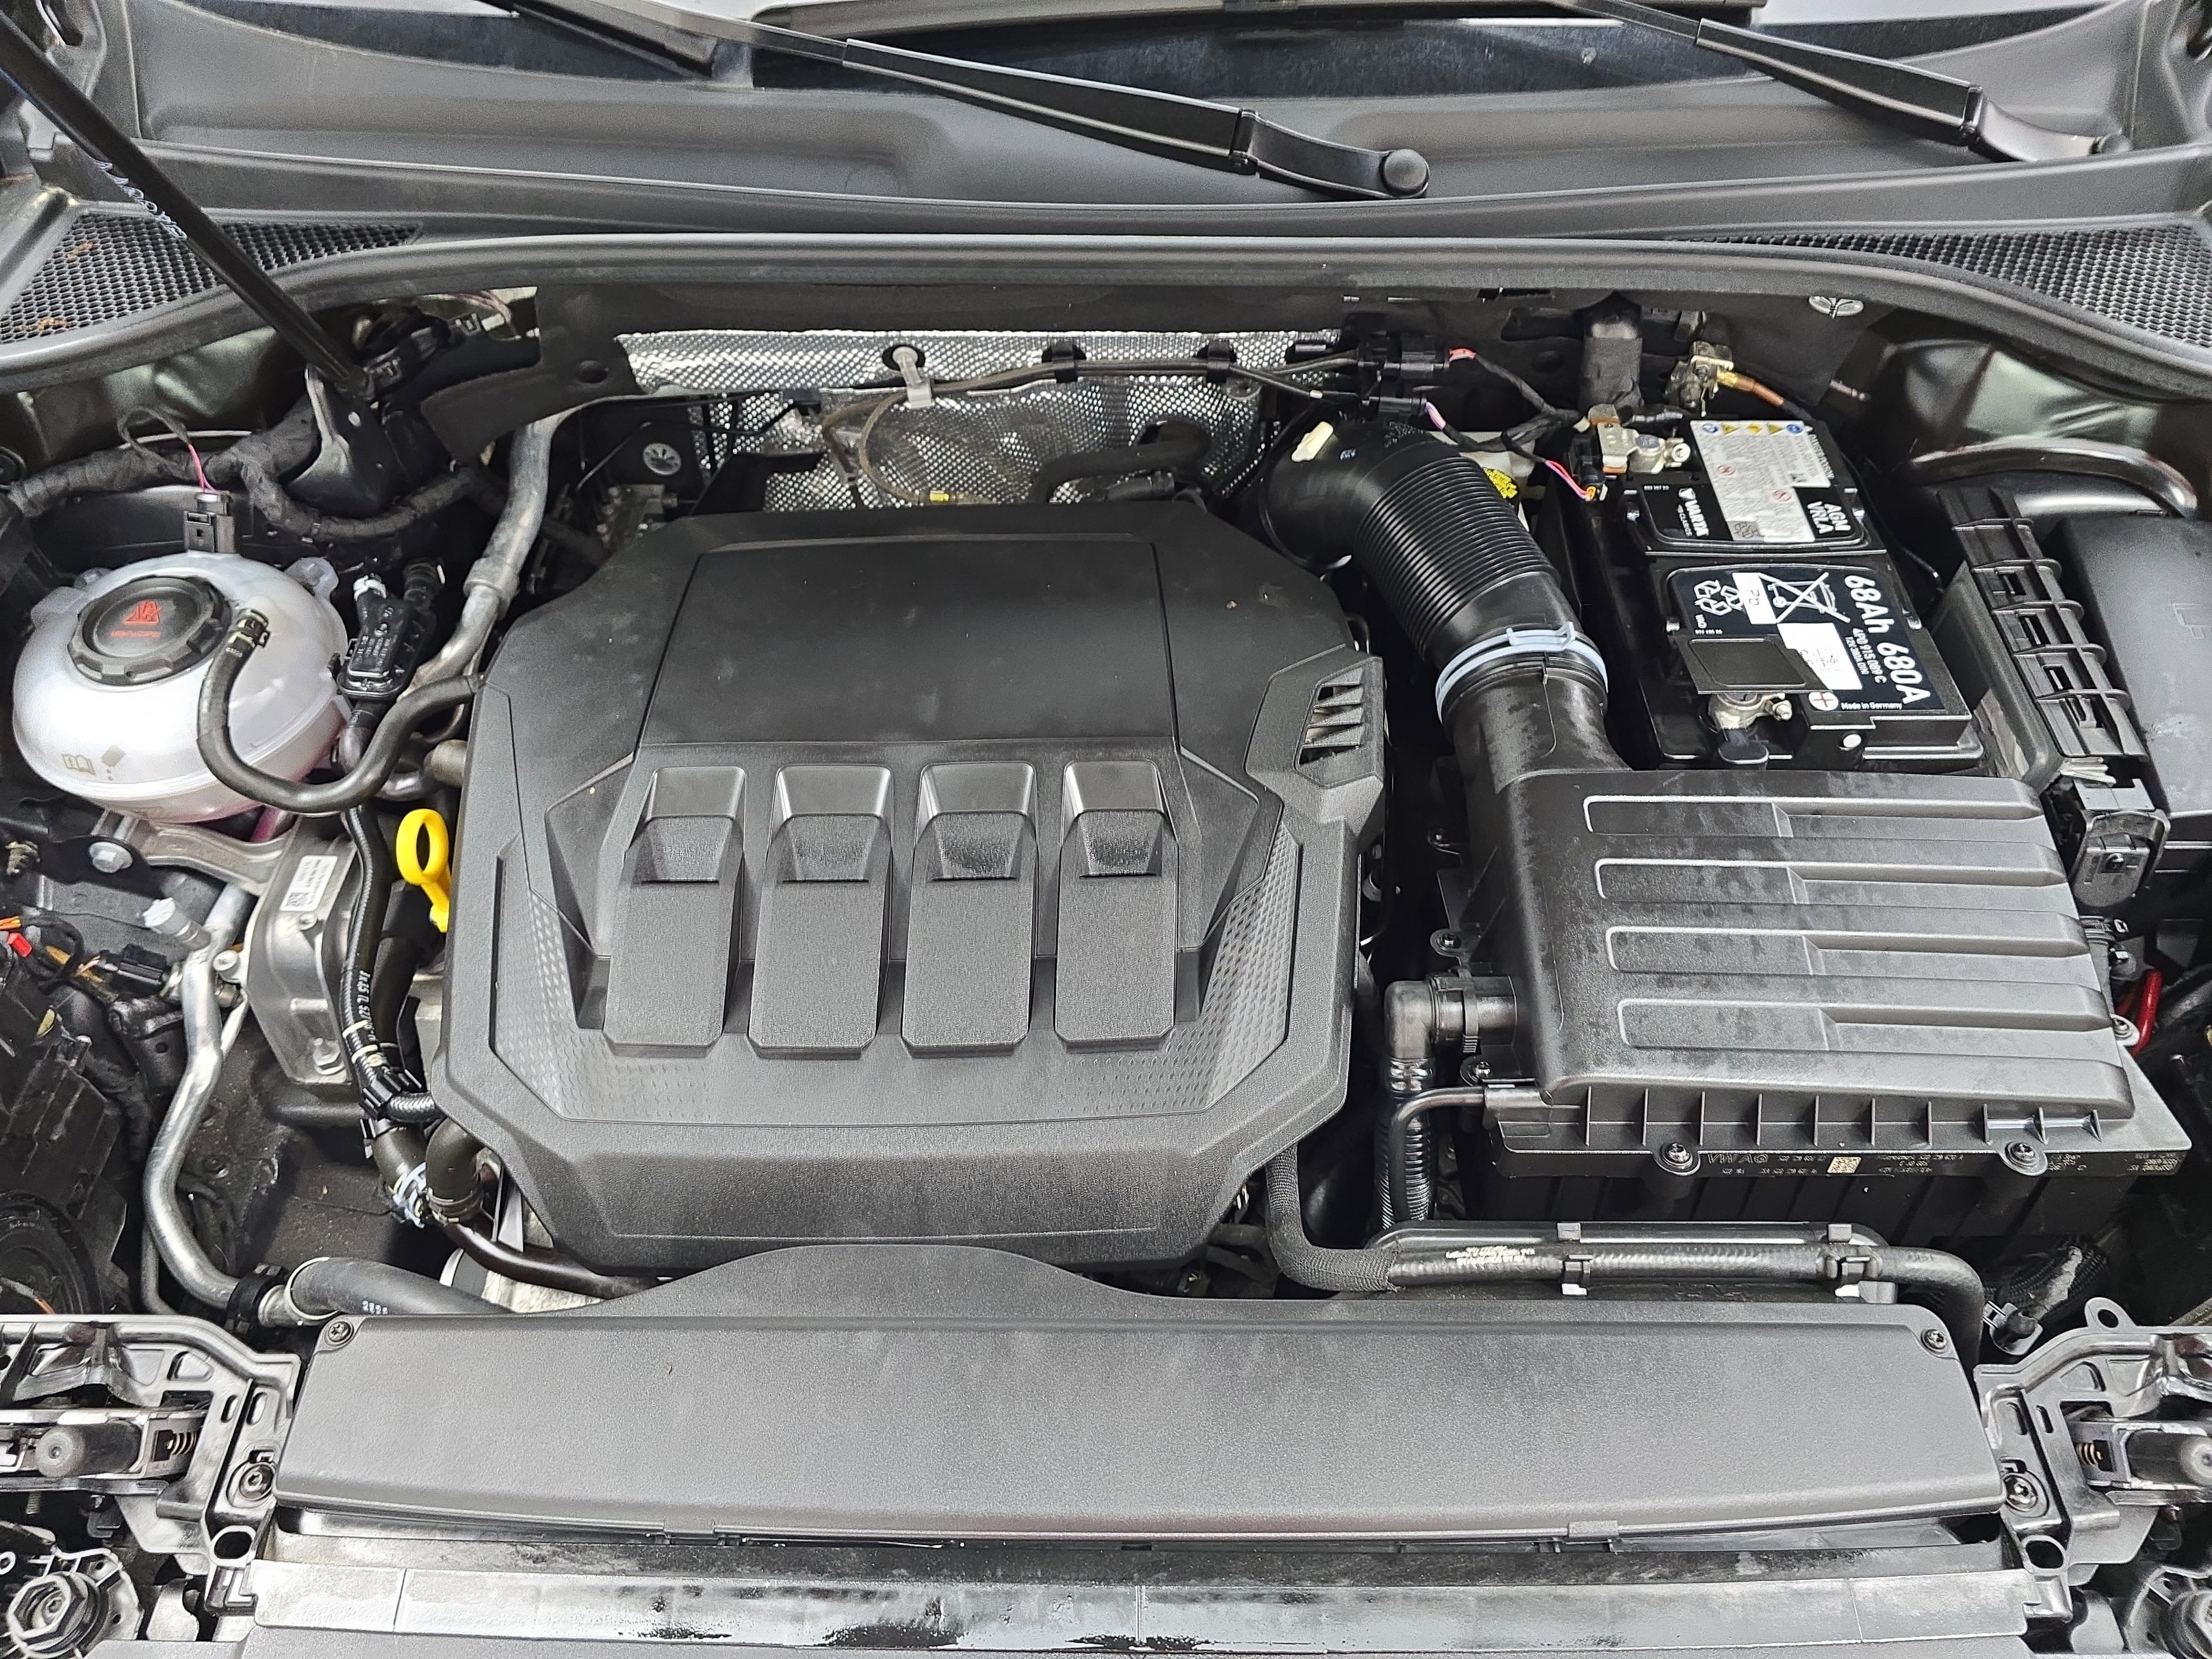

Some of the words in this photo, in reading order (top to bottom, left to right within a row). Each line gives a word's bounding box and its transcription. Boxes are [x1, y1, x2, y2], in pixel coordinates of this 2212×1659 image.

[1685, 499, 1709, 537] VARTA
[1807, 501, 1834, 534] VRLA
[1824, 503, 1851, 531] AGM
[1746, 589, 1760, 606] Pb
[1844, 575, 1895, 634] 68Ah
[1876, 642, 1931, 704] 680A
[1874, 675, 1887, 684] C
[1840, 702, 1861, 710] Made
[1869, 702, 1902, 710] Germany
